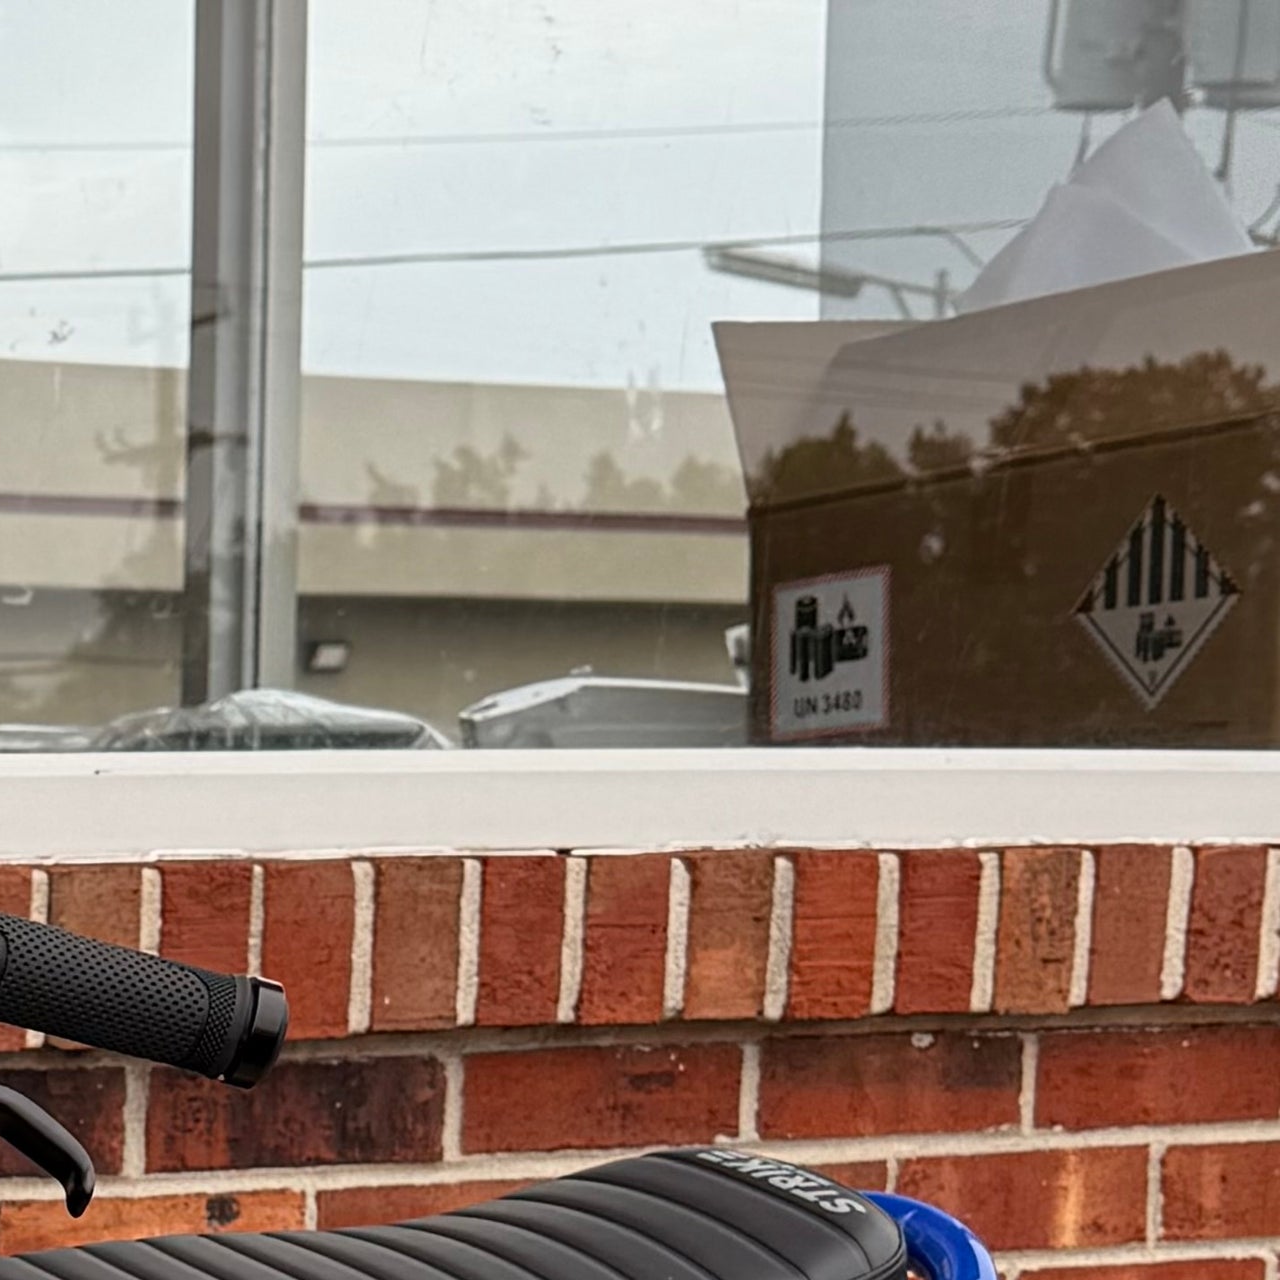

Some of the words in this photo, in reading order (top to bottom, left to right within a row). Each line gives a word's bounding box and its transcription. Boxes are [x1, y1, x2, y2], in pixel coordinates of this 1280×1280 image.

[794, 695, 818, 719] UN
[822, 690, 863, 716] 3480
[696, 1149, 867, 1214] STRIKE
